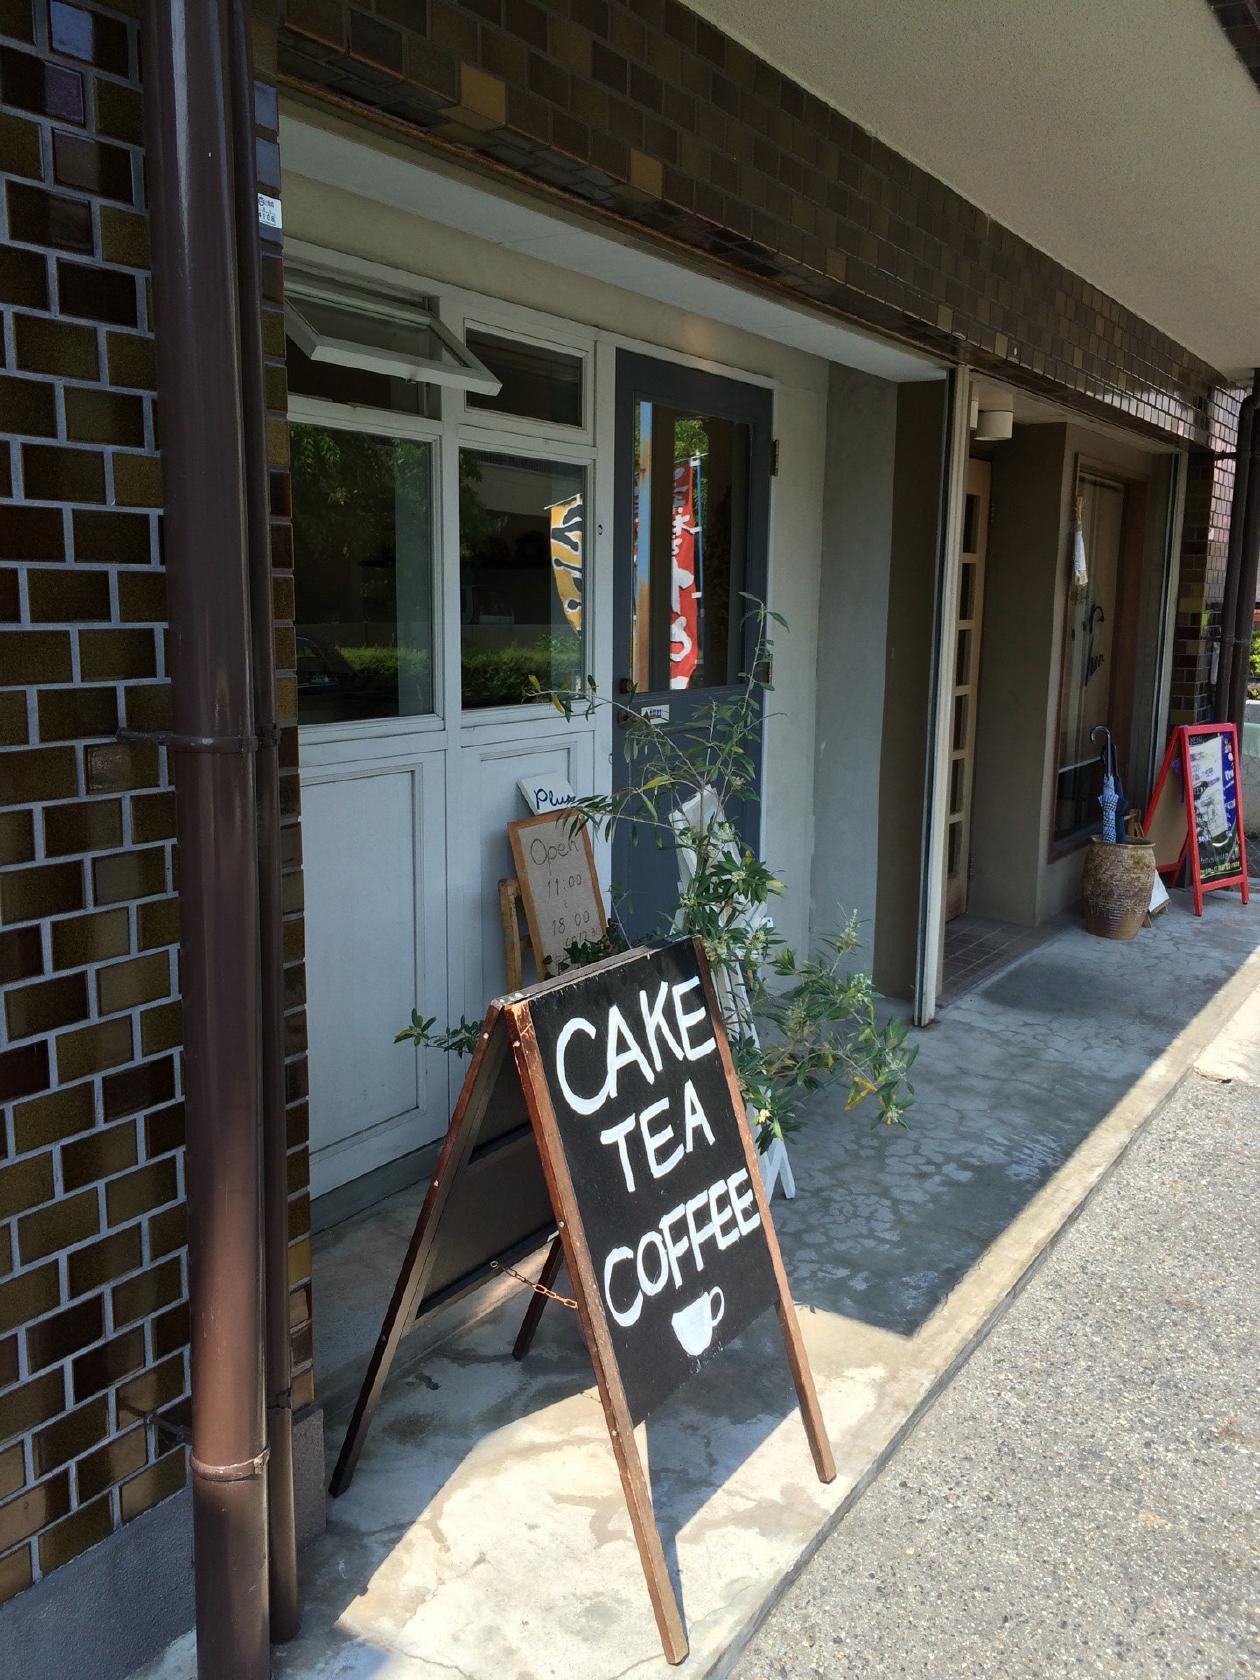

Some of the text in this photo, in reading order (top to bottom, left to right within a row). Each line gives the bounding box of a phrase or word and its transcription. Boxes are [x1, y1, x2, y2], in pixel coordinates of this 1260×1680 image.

[530, 838, 578, 875] Open
[547, 874, 582, 897] 11:00
[556, 976, 717, 1115] CAKE
[600, 1079, 715, 1193] TEA
[604, 1168, 760, 1327] COFFEE
